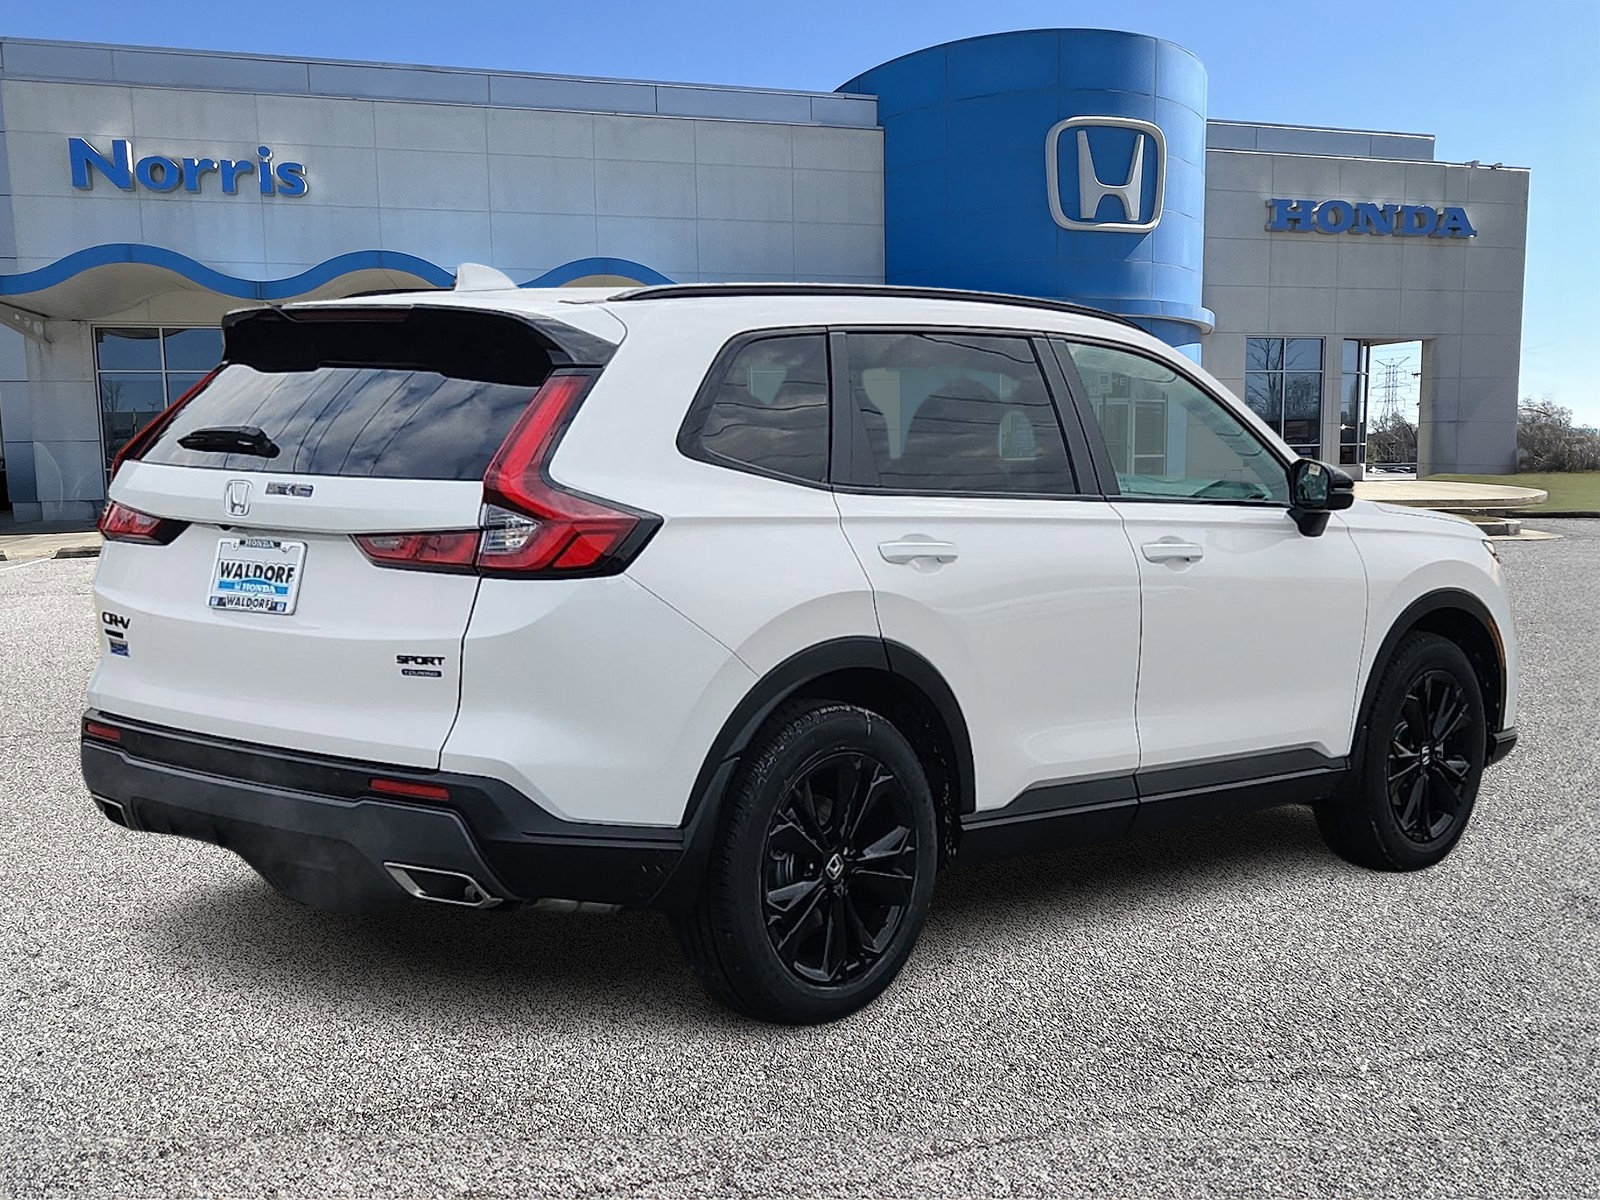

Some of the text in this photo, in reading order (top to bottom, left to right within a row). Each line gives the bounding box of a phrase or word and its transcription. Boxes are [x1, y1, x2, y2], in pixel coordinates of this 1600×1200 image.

[68, 137, 308, 197] Norris
[1265, 198, 1477, 239] HONDA
[245, 540, 275, 548] HONDA
[220, 561, 295, 583] WALDORF
[241, 583, 276, 593] HONDA
[226, 596, 272, 609] WALDORF
[102, 611, 131, 629] CR-V
[396, 655, 445, 665] SPORT
